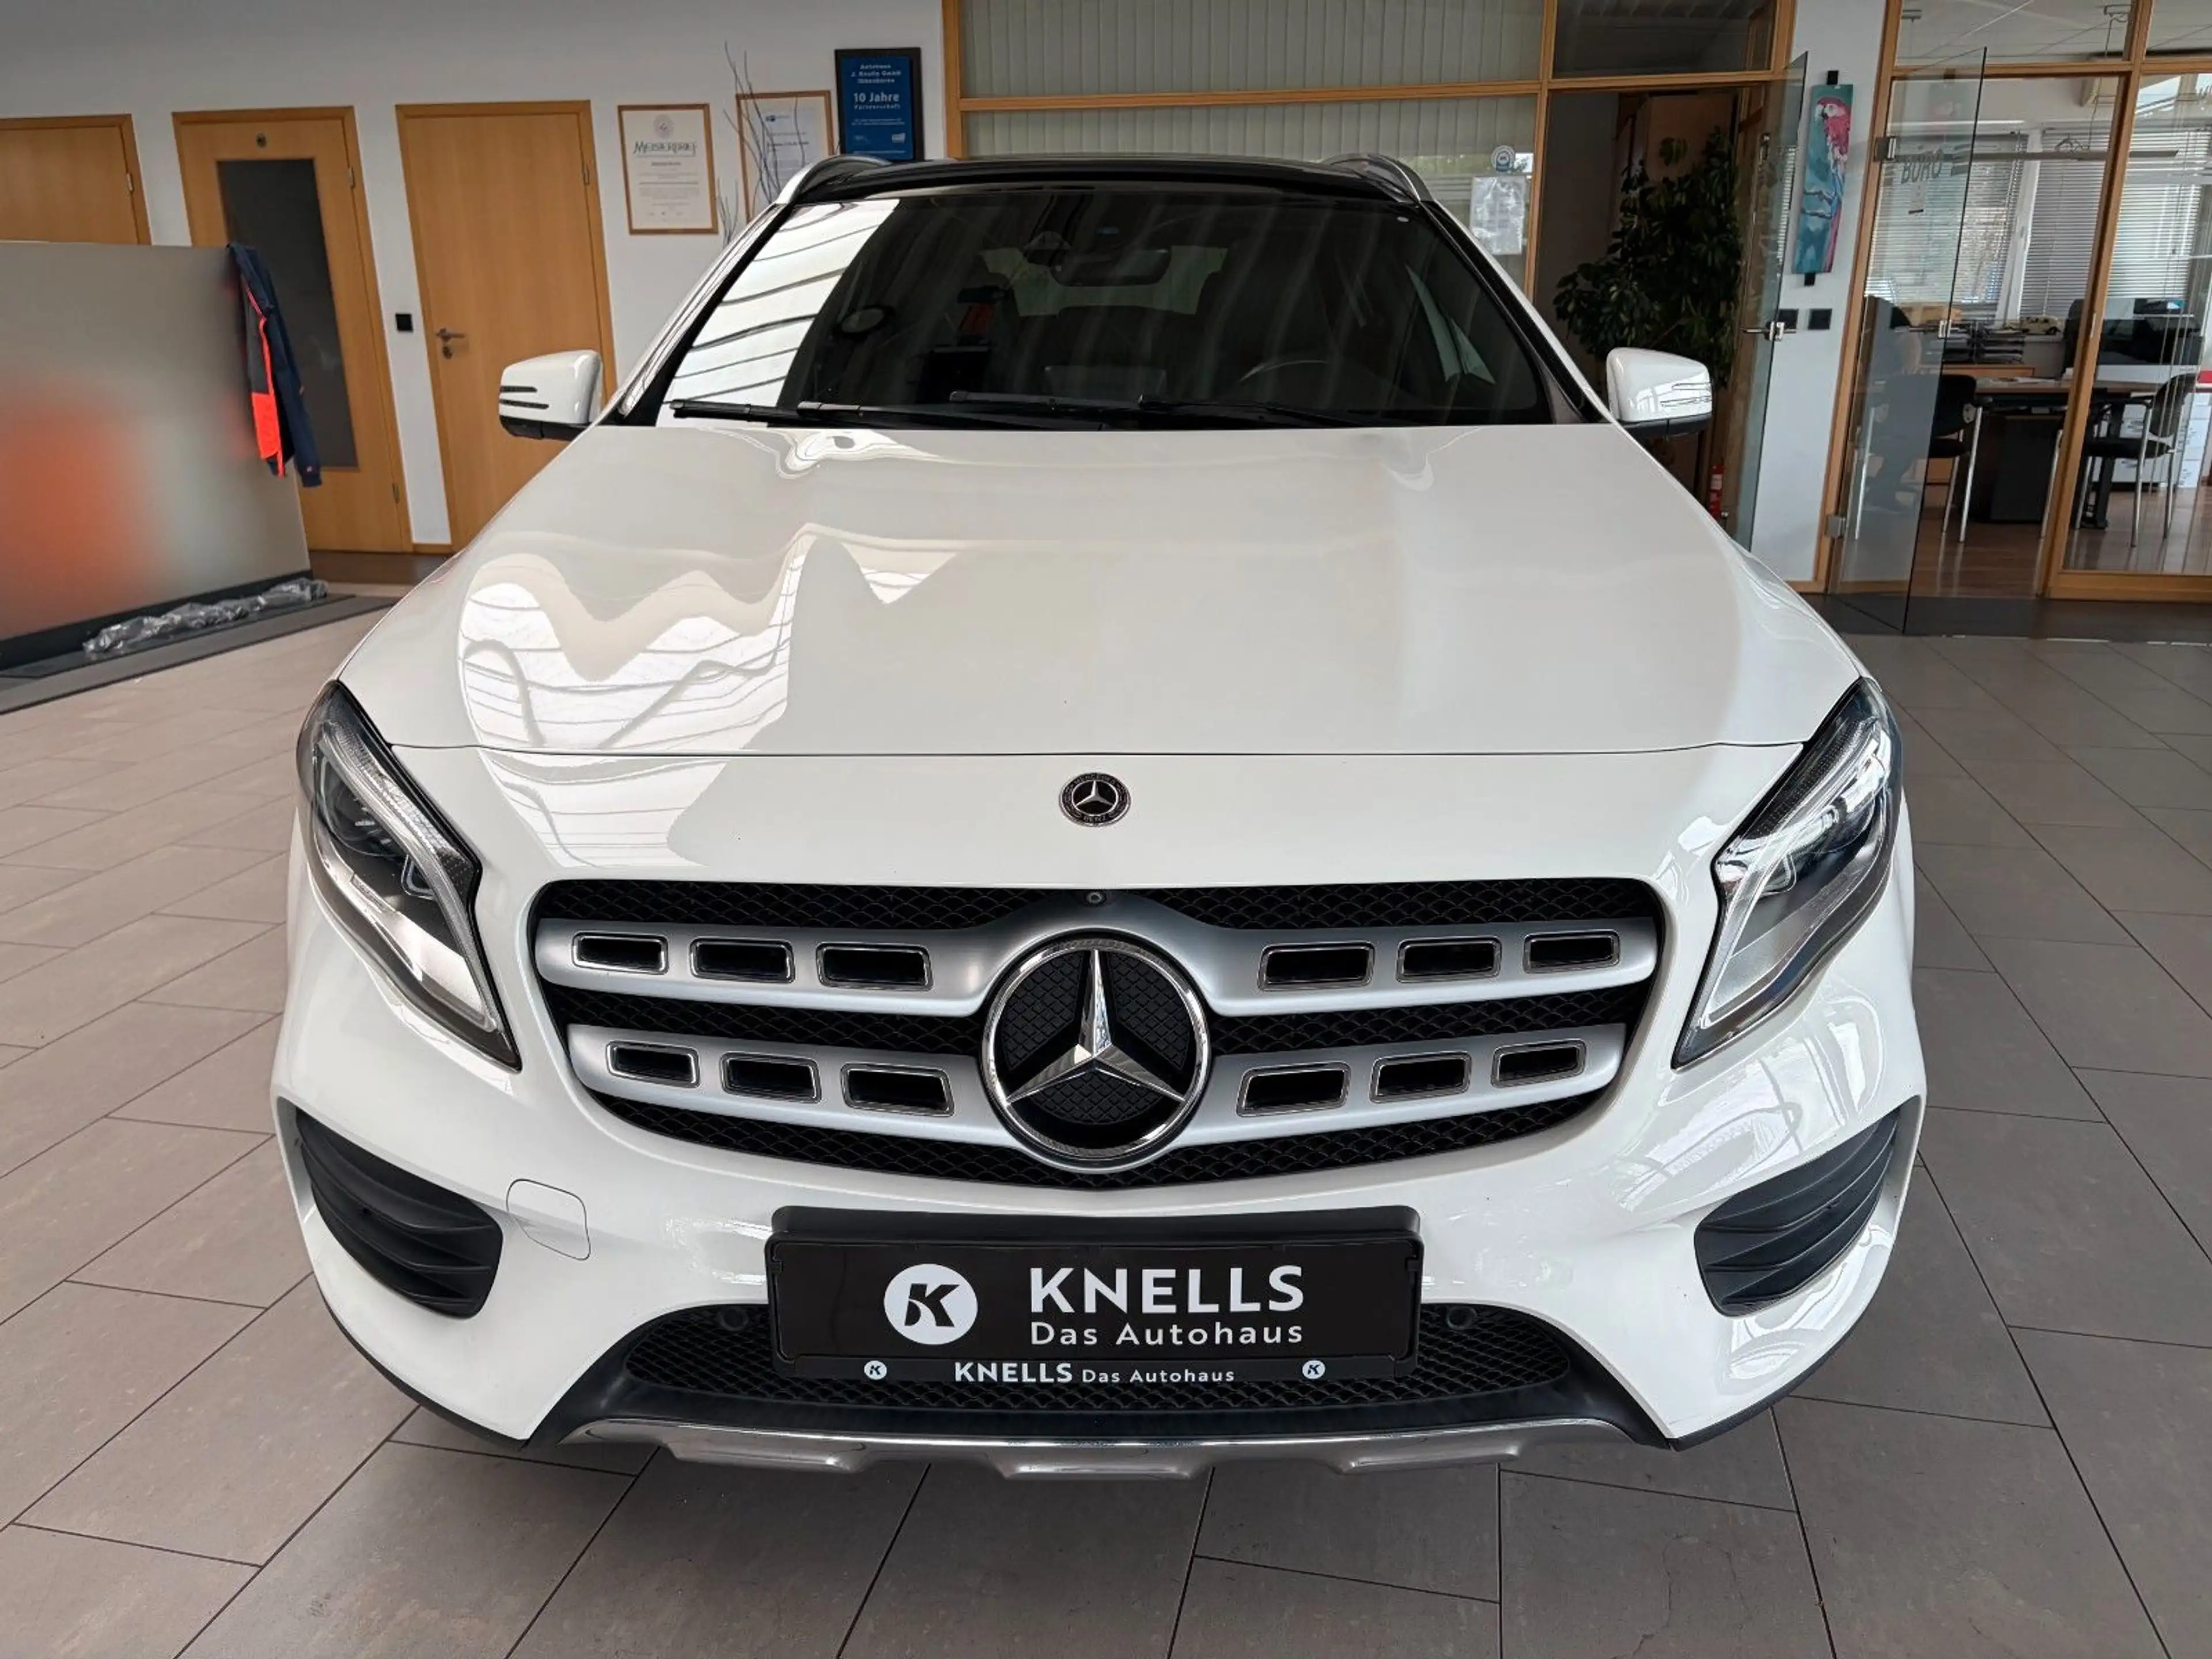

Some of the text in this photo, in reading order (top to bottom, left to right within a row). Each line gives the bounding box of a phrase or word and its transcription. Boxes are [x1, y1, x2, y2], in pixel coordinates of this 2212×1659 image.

[854, 91, 900, 103] 10 Jahre
[1031, 1266, 1303, 1313] KNELLS
[1032, 1322, 1301, 1344] Das Autohaus
[956, 1362, 1233, 1382] KNELLS Das Autohaus
